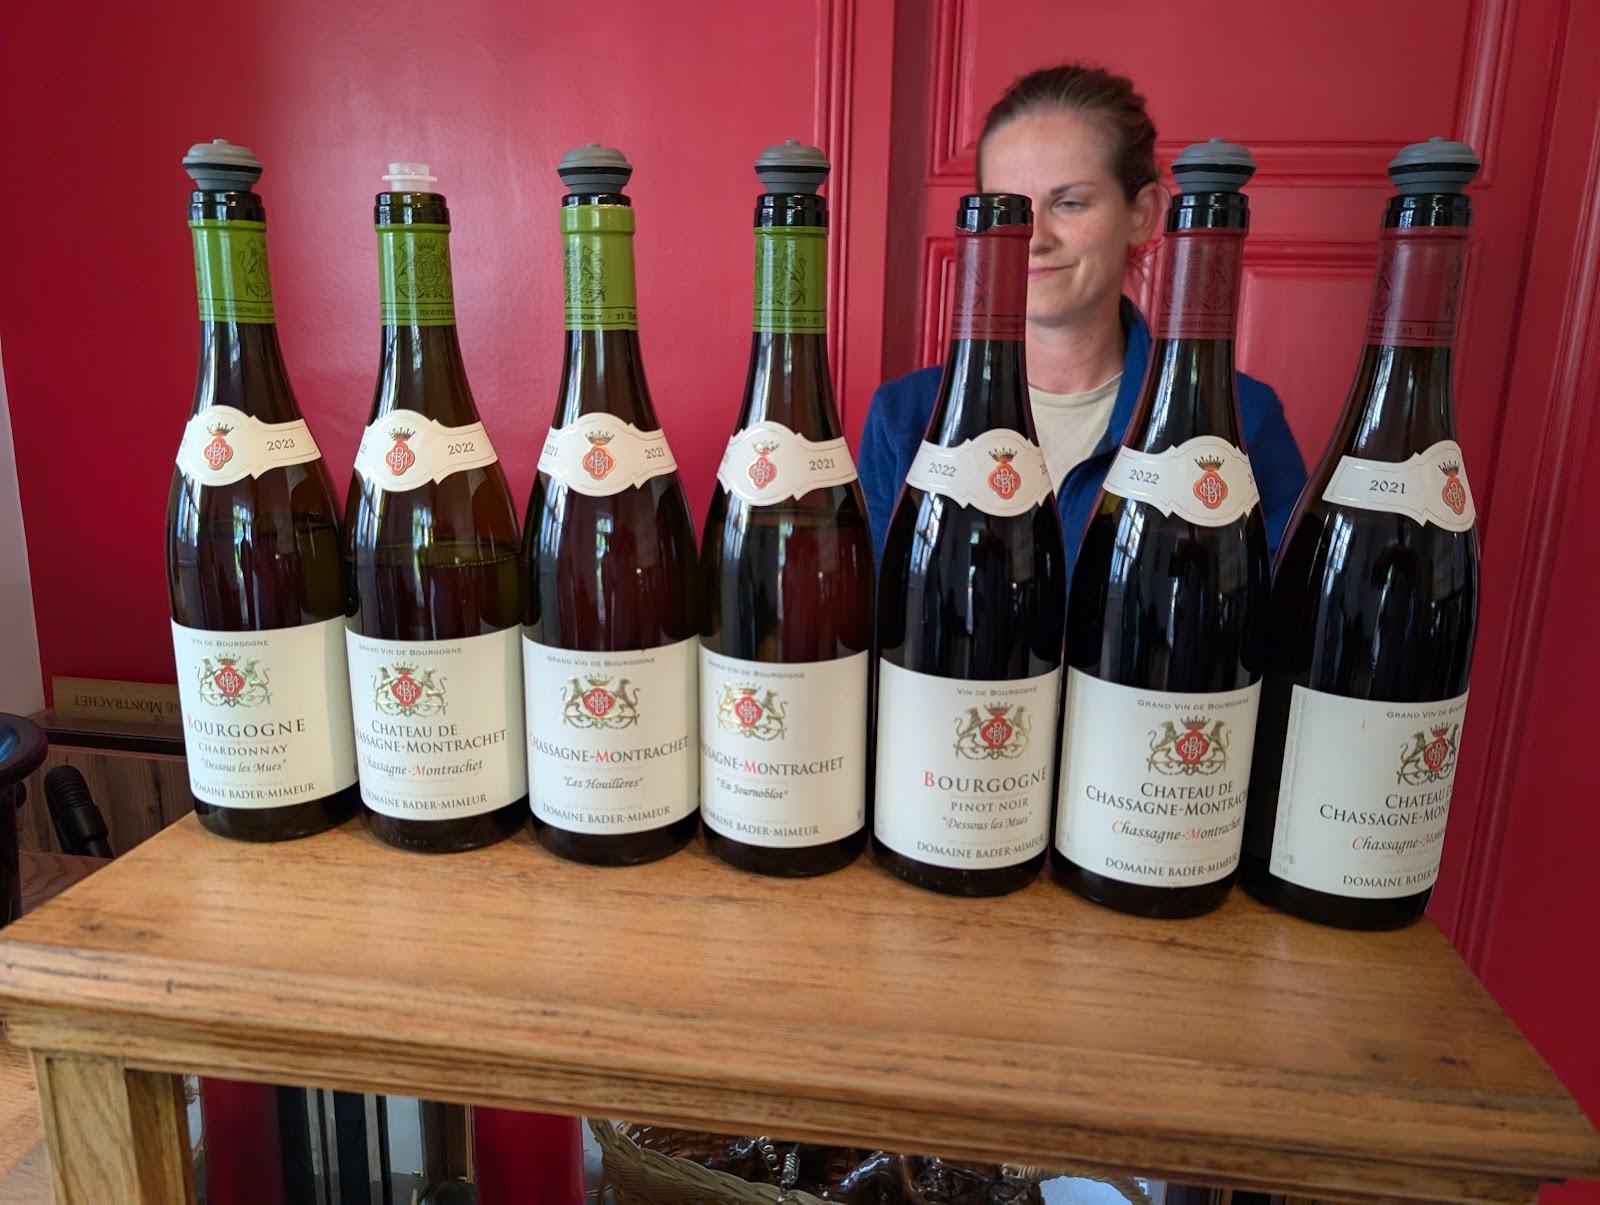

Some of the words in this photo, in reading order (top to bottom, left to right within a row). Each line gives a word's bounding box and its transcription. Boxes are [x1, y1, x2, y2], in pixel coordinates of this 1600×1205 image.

[266, 438, 296, 451] 2023
[447, 441, 475, 455] 2022
[644, 447, 665, 460] 2021
[809, 458, 835, 471] 2021
[928, 462, 957, 478] 2022
[1128, 468, 1160, 485] 2022
[1369, 479, 1406, 494] 2021
[216, 639, 269, 647] BOURGOGNE
[381, 647, 394, 655] VIN
[409, 647, 463, 656] BOURGOGNE
[604, 657, 655, 667] BOURGOGNE
[74, 695, 162, 713] MONTRACHET
[1137, 699, 1171, 710] GRAND
[1174, 703, 1191, 711] VIN
[1386, 711, 1420, 719] GRAND
[187, 713, 306, 738] BOURGOGNE
[371, 719, 432, 738] CHATEAU
[438, 724, 458, 737] DE
[198, 742, 288, 756] CHARDONNAY
[238, 762, 251, 773] les
[363, 754, 484, 777] Chassagne-Montrachet
[924, 766, 1047, 793] BOURGOGNE
[229, 782, 316, 800] BADER-MIMEUR
[1141, 782, 1214, 799] CHATEAU
[1218, 780, 1234, 796] DE
[365, 788, 400, 808] DOMAINE
[403, 794, 488, 810] BADER-MIMEUR
[951, 801, 995, 813] PINOT
[998, 797, 1030, 812] NOIR
[1385, 787, 1446, 809] CHATEAU
[543, 802, 584, 823] DOMAINE
[588, 806, 671, 824] BADER-MIMEUR
[736, 822, 820, 838] BADER-MIMEUR
[917, 841, 971, 859] DOMAINE
[1105, 857, 1163, 876] DOMAINE
[1343, 874, 1404, 888] DOMAINE
